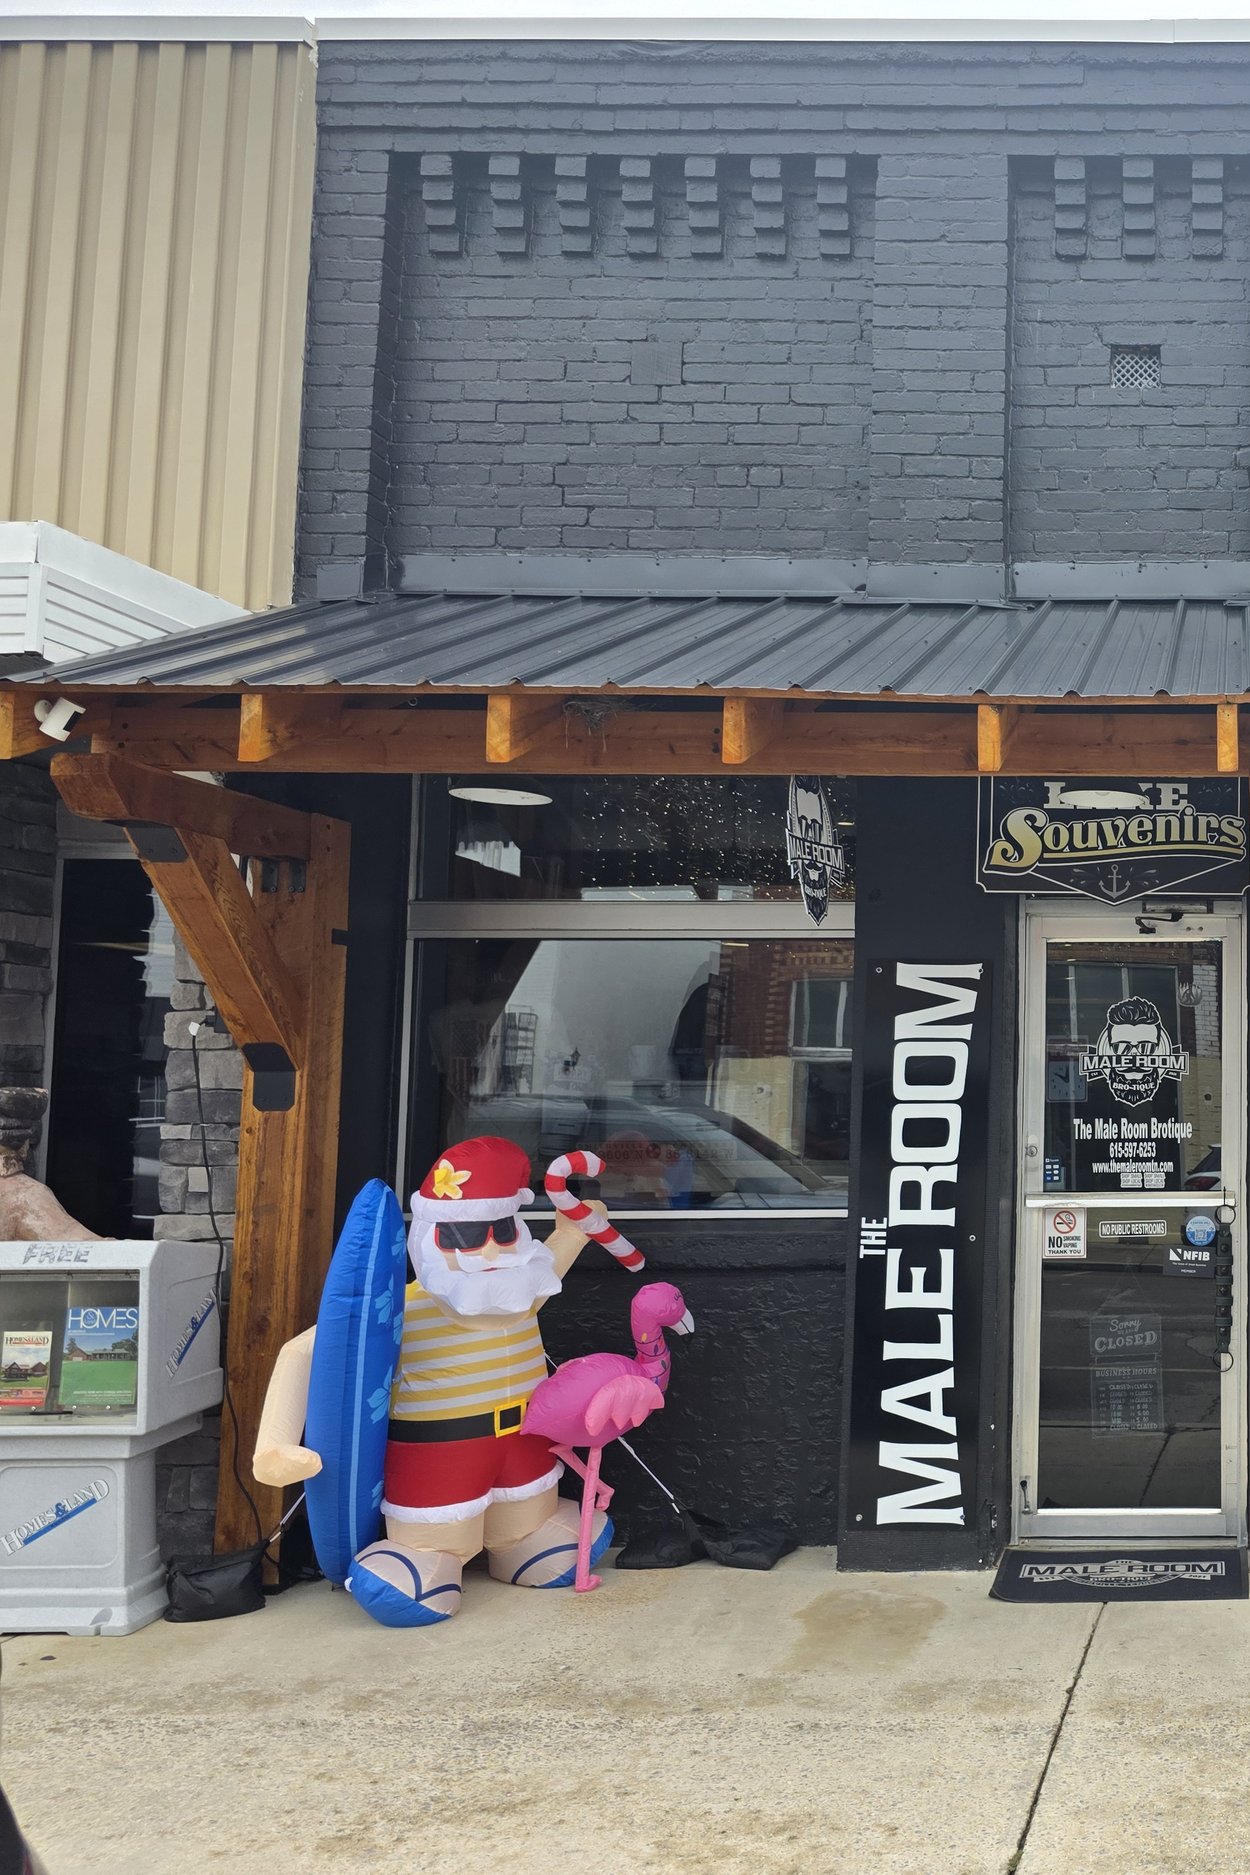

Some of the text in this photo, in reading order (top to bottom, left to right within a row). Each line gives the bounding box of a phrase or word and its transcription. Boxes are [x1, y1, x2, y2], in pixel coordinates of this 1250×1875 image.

[984, 804, 1246, 873] Souvenirs
[812, 842, 843, 870] ROOM
[1083, 1055, 1185, 1070] MALE ROOM
[1112, 1081, 1156, 1092] BRO-TIQUE
[1073, 1117, 1193, 1143] The Male Room Brotique
[1109, 1142, 1157, 1158] 615-597-6253
[1092, 1159, 1174, 1173] www.themaleroomtn.com
[1101, 1222, 1165, 1235] NO PUBLIC RESTROOMS
[859, 1216, 887, 1258] THE
[876, 962, 983, 1526] MALE ROOM
[1048, 1236, 1063, 1249] NO
[22, 1244, 93, 1265] FREE
[1183, 1250, 1210, 1261] NFIB
[67, 1308, 138, 1330] HOMES
[1109, 1319, 1142, 1333] Sorry
[1094, 1330, 1158, 1353] CLOSED
[1095, 1367, 1158, 1378] BUSINESS HOURS
[0, 1479, 110, 1557] HOMES&LAND
[1027, 1564, 1219, 1576] MALE ROOM
